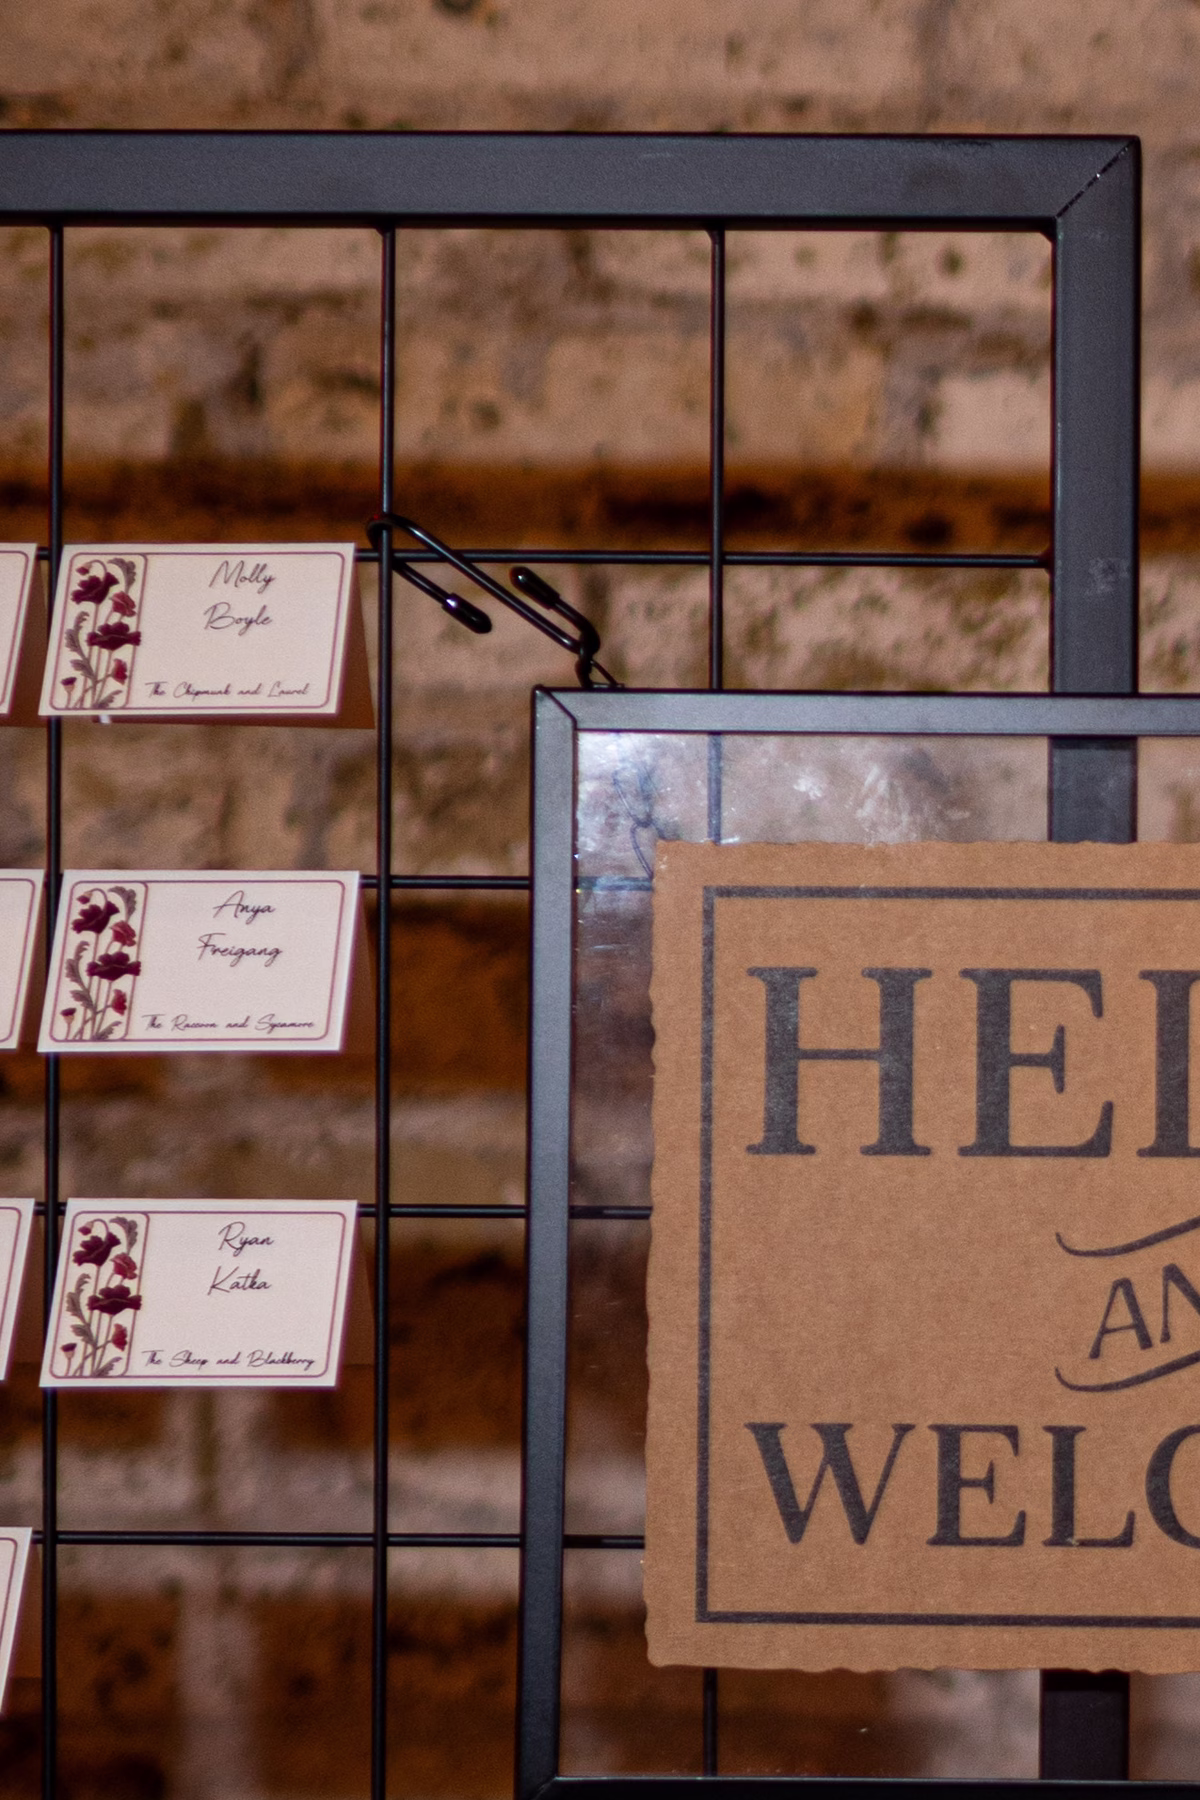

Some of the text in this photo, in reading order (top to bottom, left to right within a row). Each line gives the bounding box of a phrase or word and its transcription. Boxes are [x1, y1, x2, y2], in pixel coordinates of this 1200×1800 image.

[208, 559, 276, 595] Molly
[203, 601, 273, 638] Boyle
[145, 681, 310, 701] The Chipmunk and Laurel
[214, 889, 276, 926] Anya
[198, 932, 283, 969] Freigang
[142, 1013, 315, 1035] The Raccoon and Sycamore
[218, 1220, 274, 1258] Ryan
[142, 1349, 316, 1372] The Sheep and Blackberry
